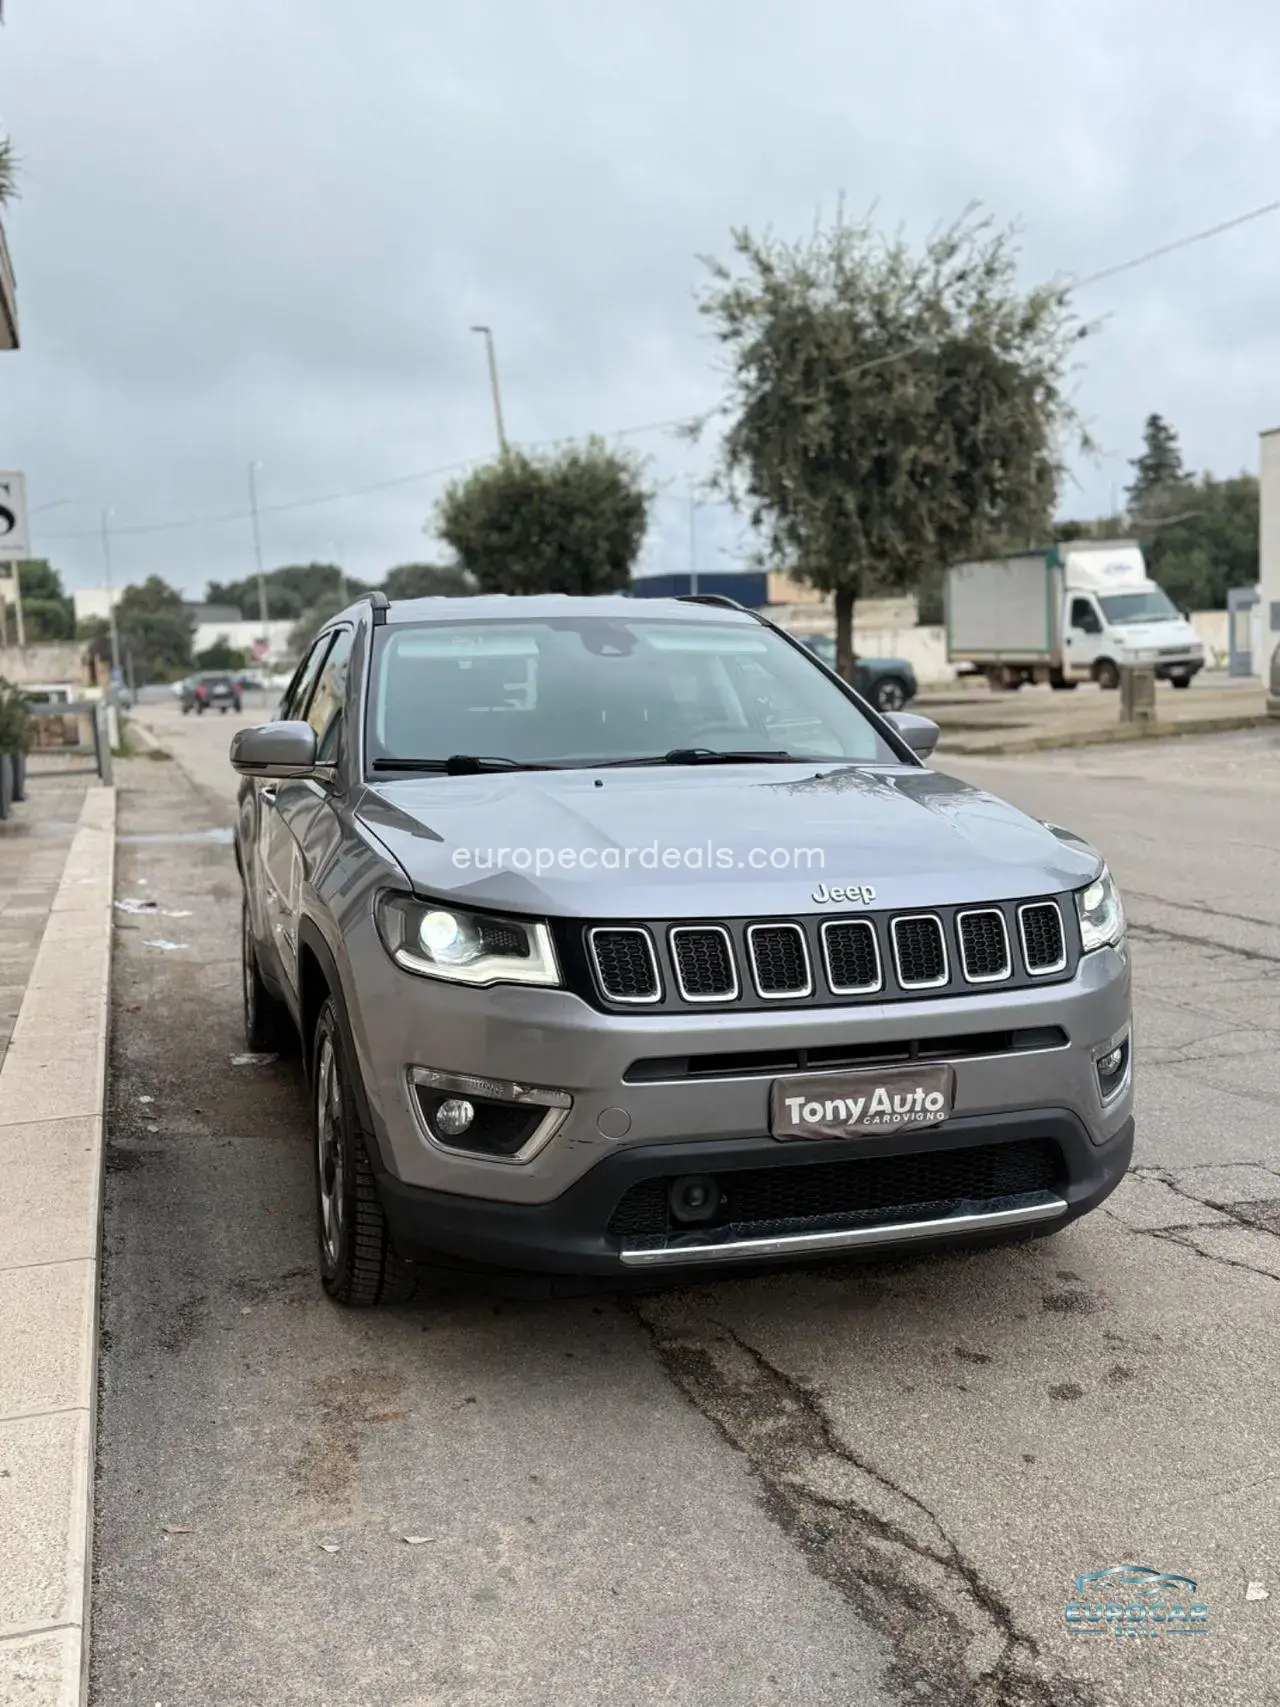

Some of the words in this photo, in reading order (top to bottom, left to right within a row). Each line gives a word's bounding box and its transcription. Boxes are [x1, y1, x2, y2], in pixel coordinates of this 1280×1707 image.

[811, 883, 876, 905] Jeep
[785, 1096, 866, 1125] Tony
[867, 1087, 945, 1116] Auto
[863, 1112, 945, 1125] CAROVIGNO
